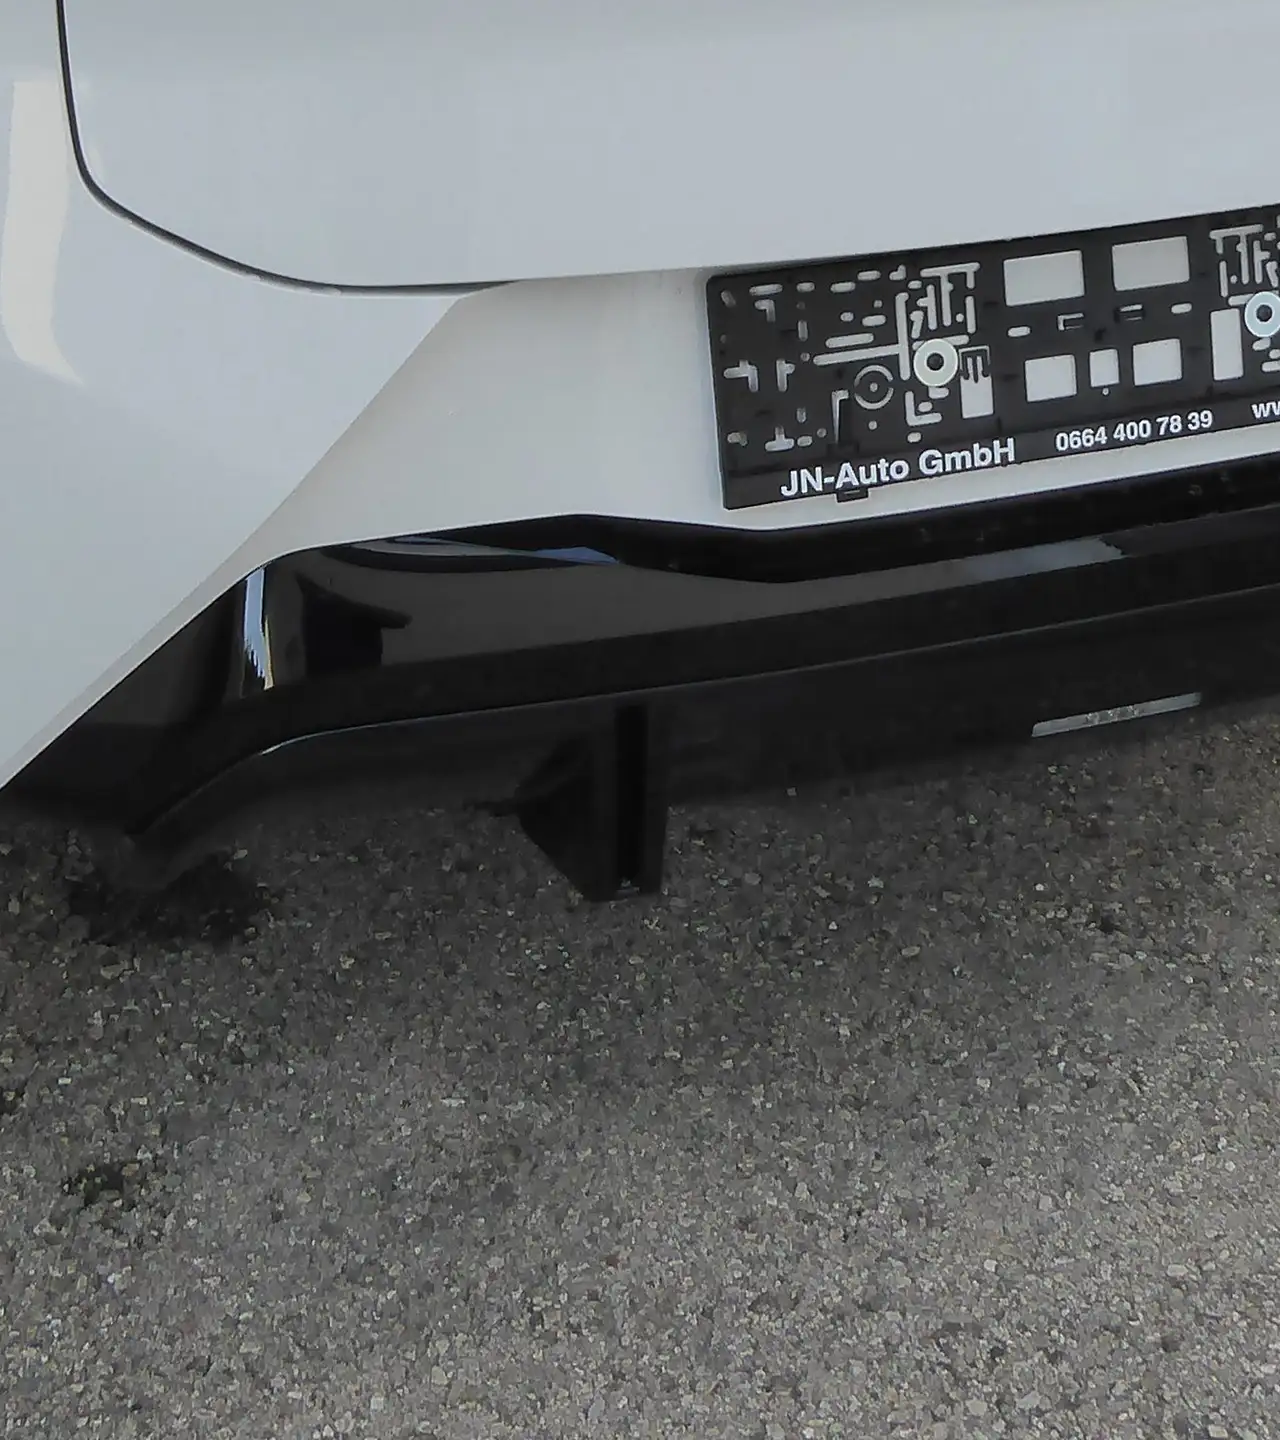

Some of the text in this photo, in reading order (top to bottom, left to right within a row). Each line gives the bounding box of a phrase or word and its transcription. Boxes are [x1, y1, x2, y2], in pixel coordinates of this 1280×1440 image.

[780, 459, 909, 497] JN-Auto
[919, 437, 1016, 476] GmbH
[1055, 427, 1107, 452] 0664
[1113, 418, 1153, 442] 400
[1156, 414, 1183, 436] 78
[1187, 410, 1213, 430] 39
